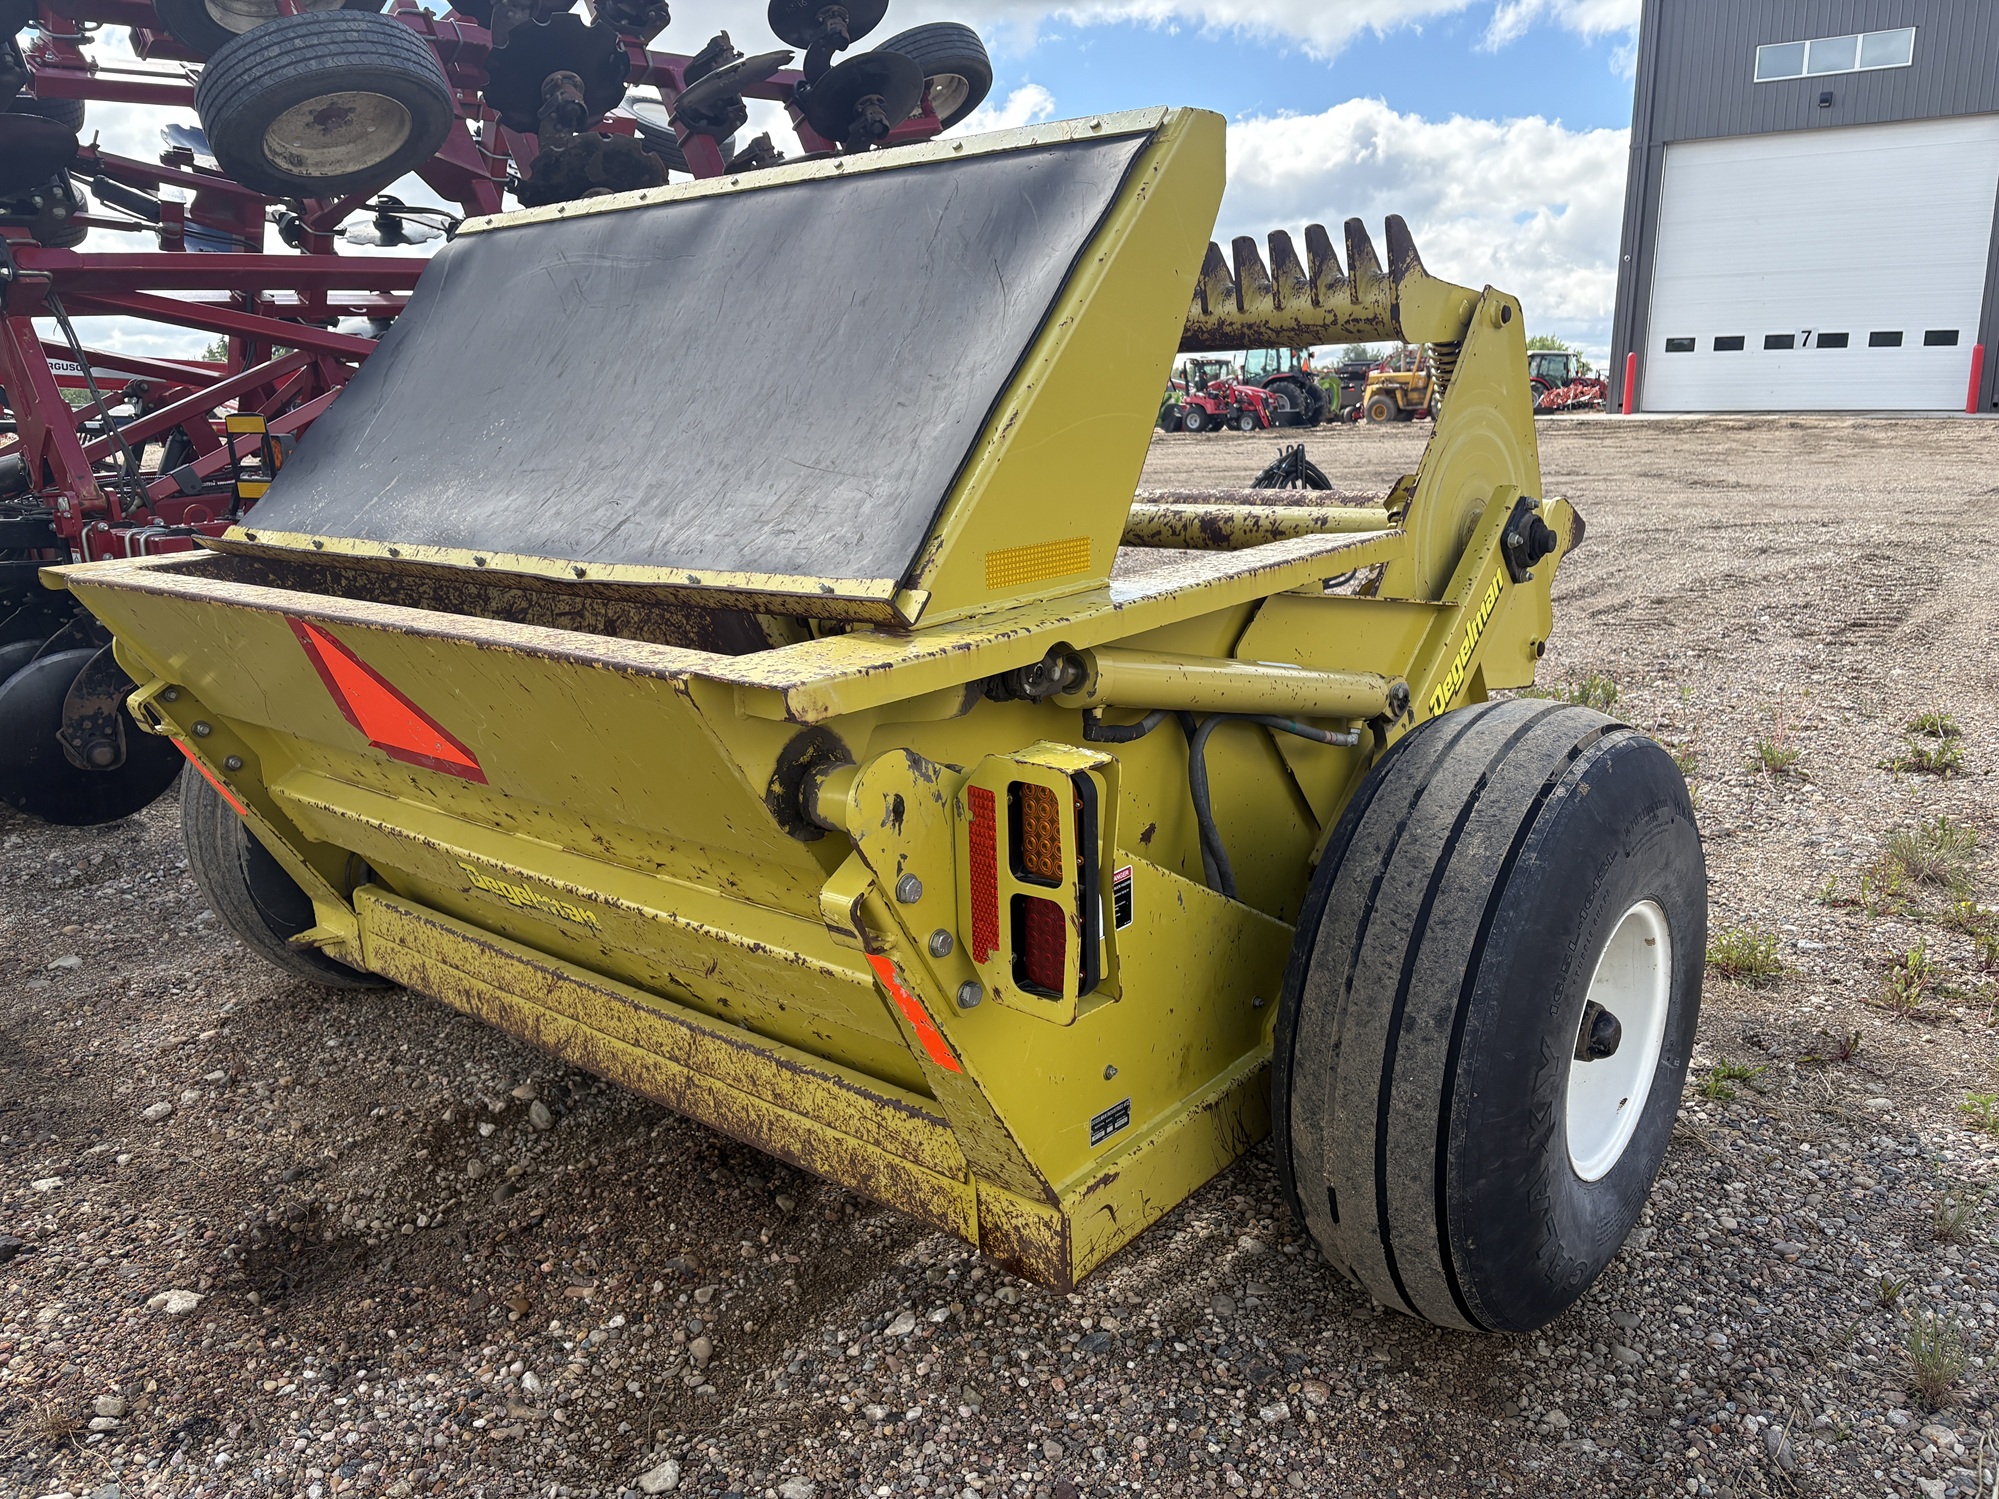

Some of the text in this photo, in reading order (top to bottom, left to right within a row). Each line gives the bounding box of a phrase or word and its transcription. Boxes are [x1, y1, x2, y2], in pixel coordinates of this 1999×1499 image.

[1801, 330, 1812, 347] 7
[1429, 566, 1504, 717] Degelman
[456, 860, 602, 932] Degelman
[1527, 1035, 1589, 1291] GALAXY
